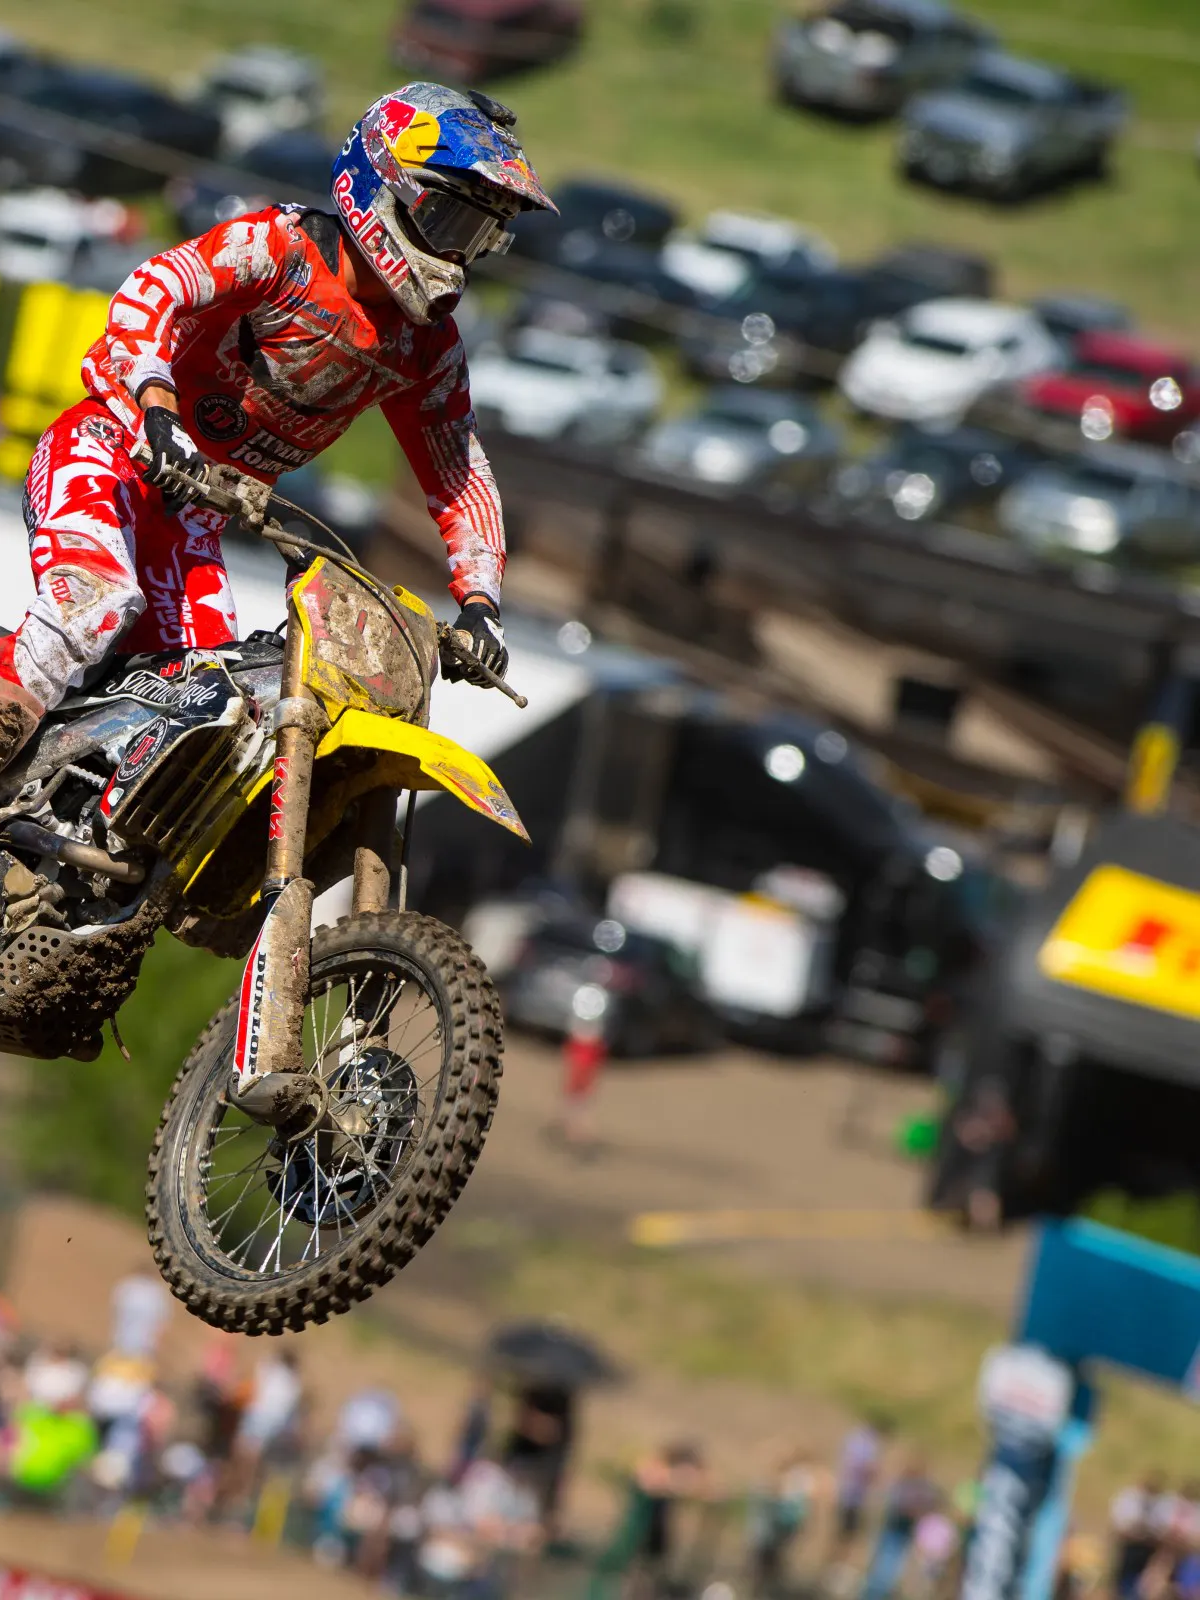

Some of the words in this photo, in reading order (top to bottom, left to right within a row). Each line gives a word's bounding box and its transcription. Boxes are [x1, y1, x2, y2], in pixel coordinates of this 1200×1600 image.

[336, 169, 377, 237] Red
[359, 218, 409, 291] Bull
[106, 669, 178, 705] Soarin
[248, 951, 267, 1075] DUNLOP
